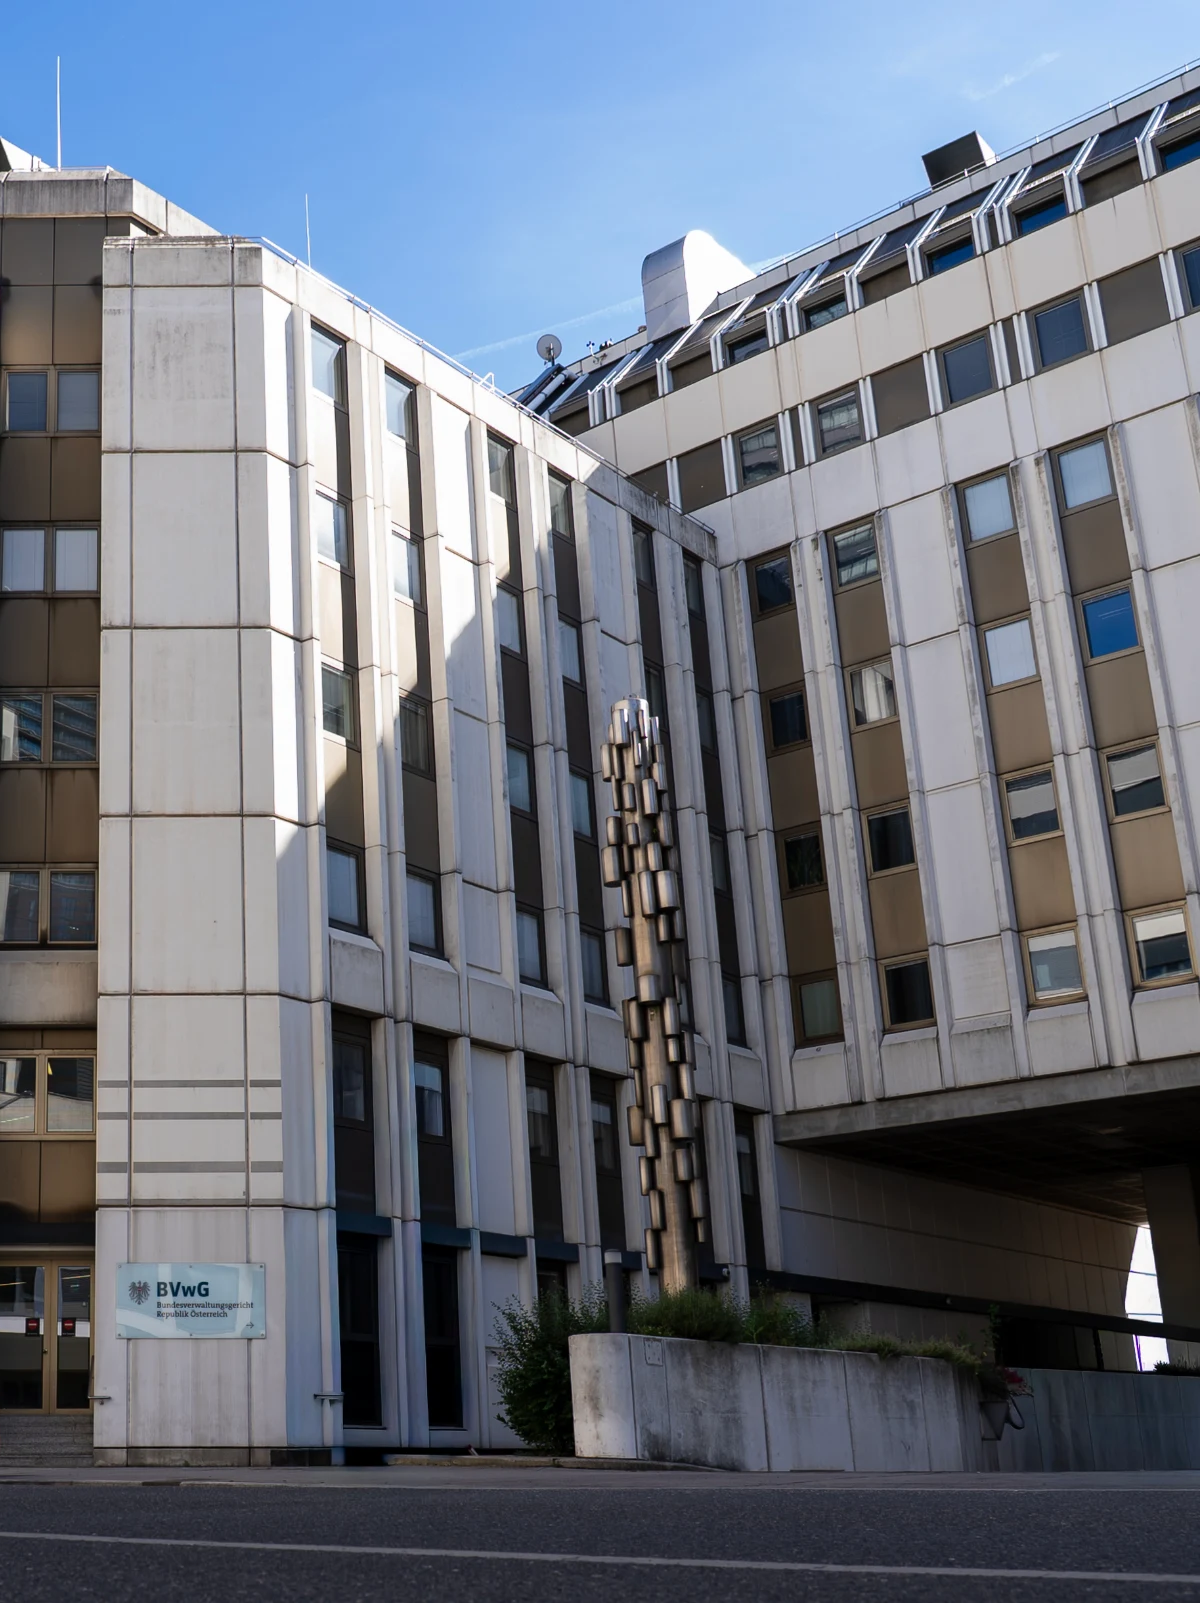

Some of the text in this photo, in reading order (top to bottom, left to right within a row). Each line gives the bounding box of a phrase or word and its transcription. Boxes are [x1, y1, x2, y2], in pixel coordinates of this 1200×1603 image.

[156, 1281, 210, 1298] BVwG
[156, 1301, 254, 1310] Bundesverwaltungsgericht
[156, 1310, 228, 1319] Republik Österreich
